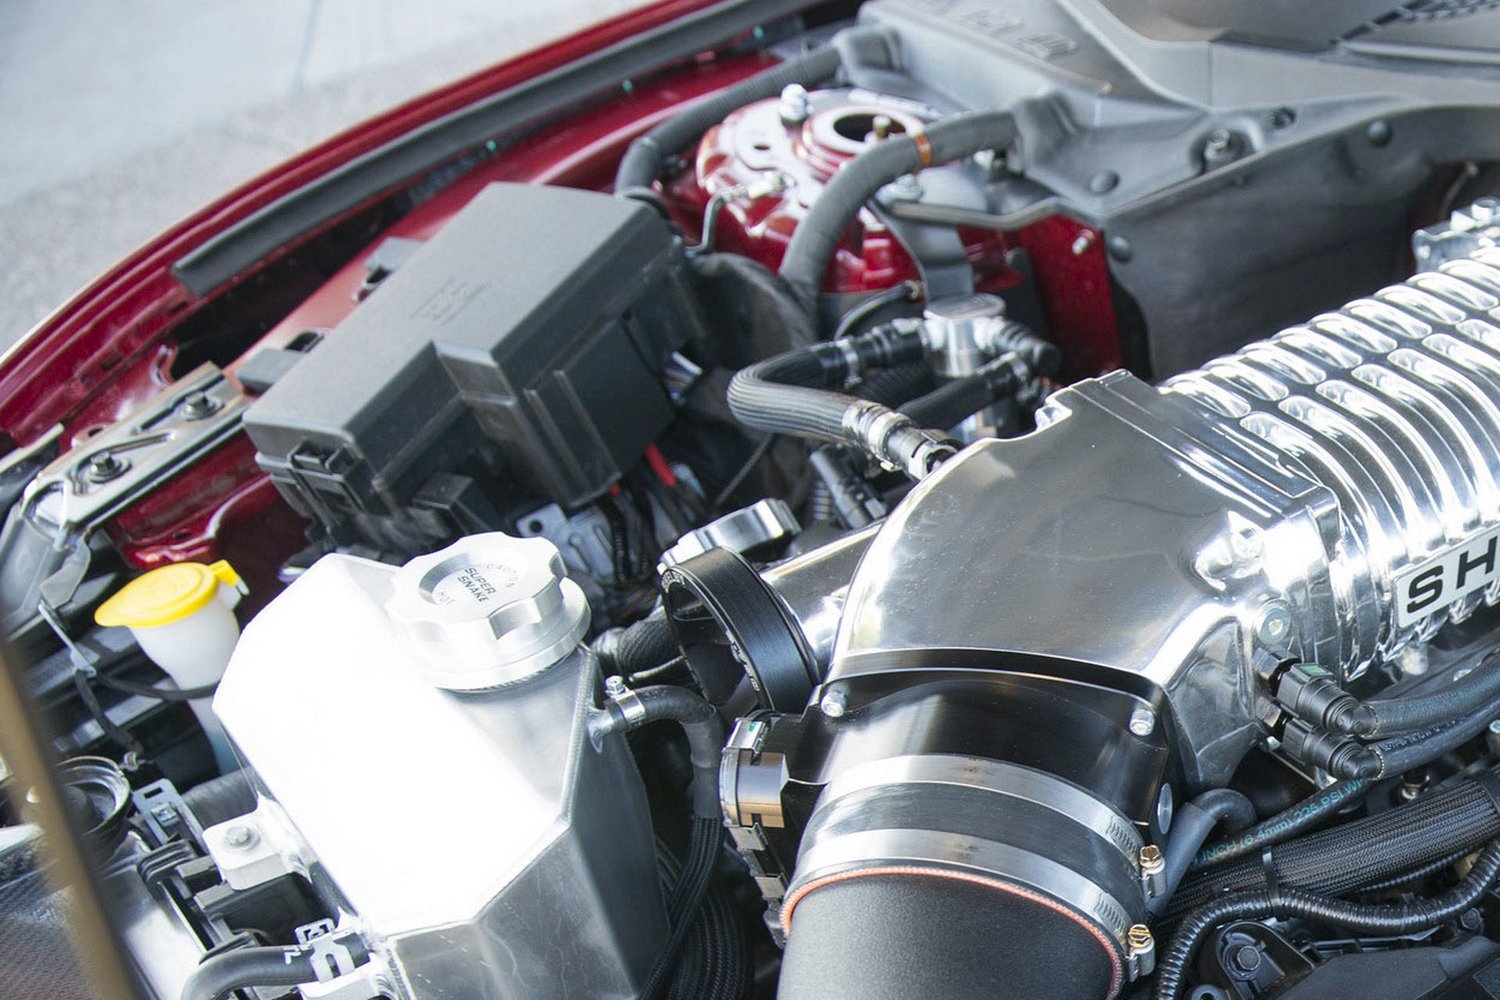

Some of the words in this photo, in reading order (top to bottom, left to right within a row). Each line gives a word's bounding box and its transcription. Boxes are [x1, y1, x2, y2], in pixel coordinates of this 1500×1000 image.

[458, 576, 490, 602] SNAKE
[465, 567, 497, 594] SUPER
[1294, 803, 1319, 826] 225
[1321, 788, 1345, 807] PSI
